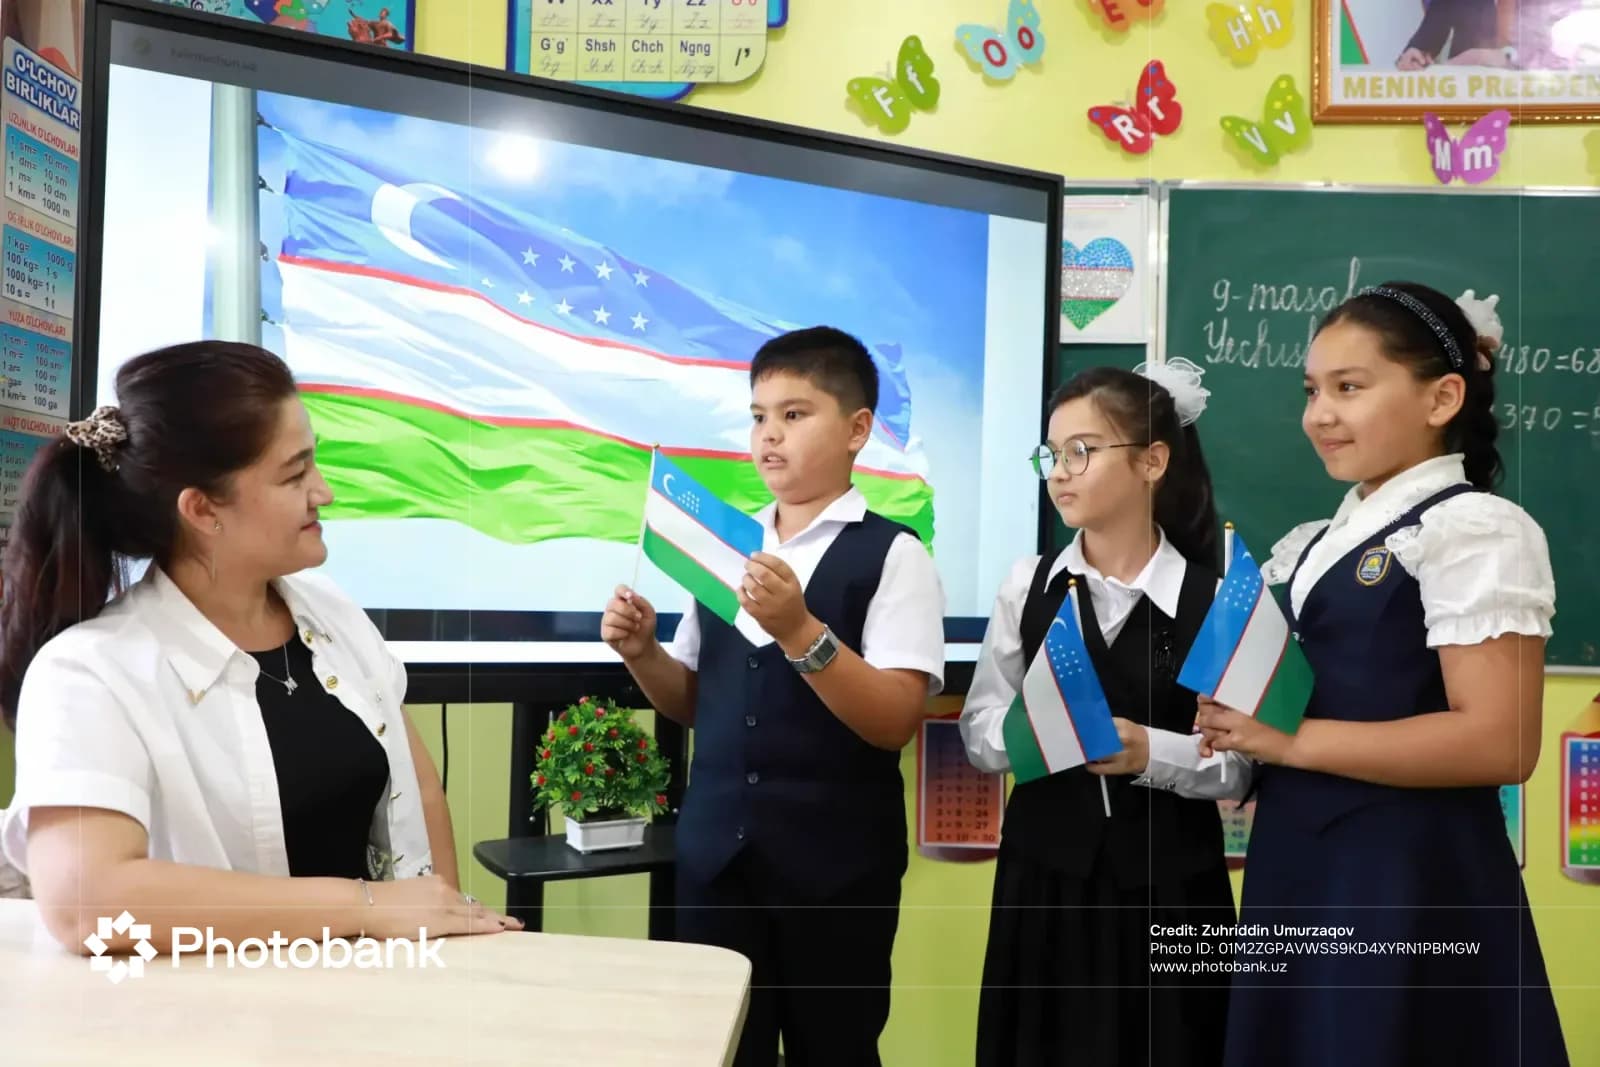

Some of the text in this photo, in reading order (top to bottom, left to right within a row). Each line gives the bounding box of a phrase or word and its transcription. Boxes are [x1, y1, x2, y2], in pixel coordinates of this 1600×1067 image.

[1226, 5, 1281, 50] H h
[585, 38, 616, 52] Shsh
[632, 39, 664, 53] Chch
[680, 40, 711, 56] Ngng
[983, 26, 1035, 67] O o
[16, 54, 76, 101] O‘LCHOV
[873, 64, 925, 118] F f
[1343, 75, 1457, 99] MENING
[1111, 96, 1165, 144] R r
[1244, 126, 1268, 153] V
[1434, 138, 1493, 171] M m
[44, 168, 53, 180] 10
[44, 183, 52, 194] 10
[42, 198, 60, 213] 1000
[7, 252, 20, 265] 100
[6, 267, 26, 282] 1000
[6, 283, 15, 295] 10
[35, 369, 48, 380] 100
[34, 383, 47, 393] 100
[34, 396, 47, 407] 100
